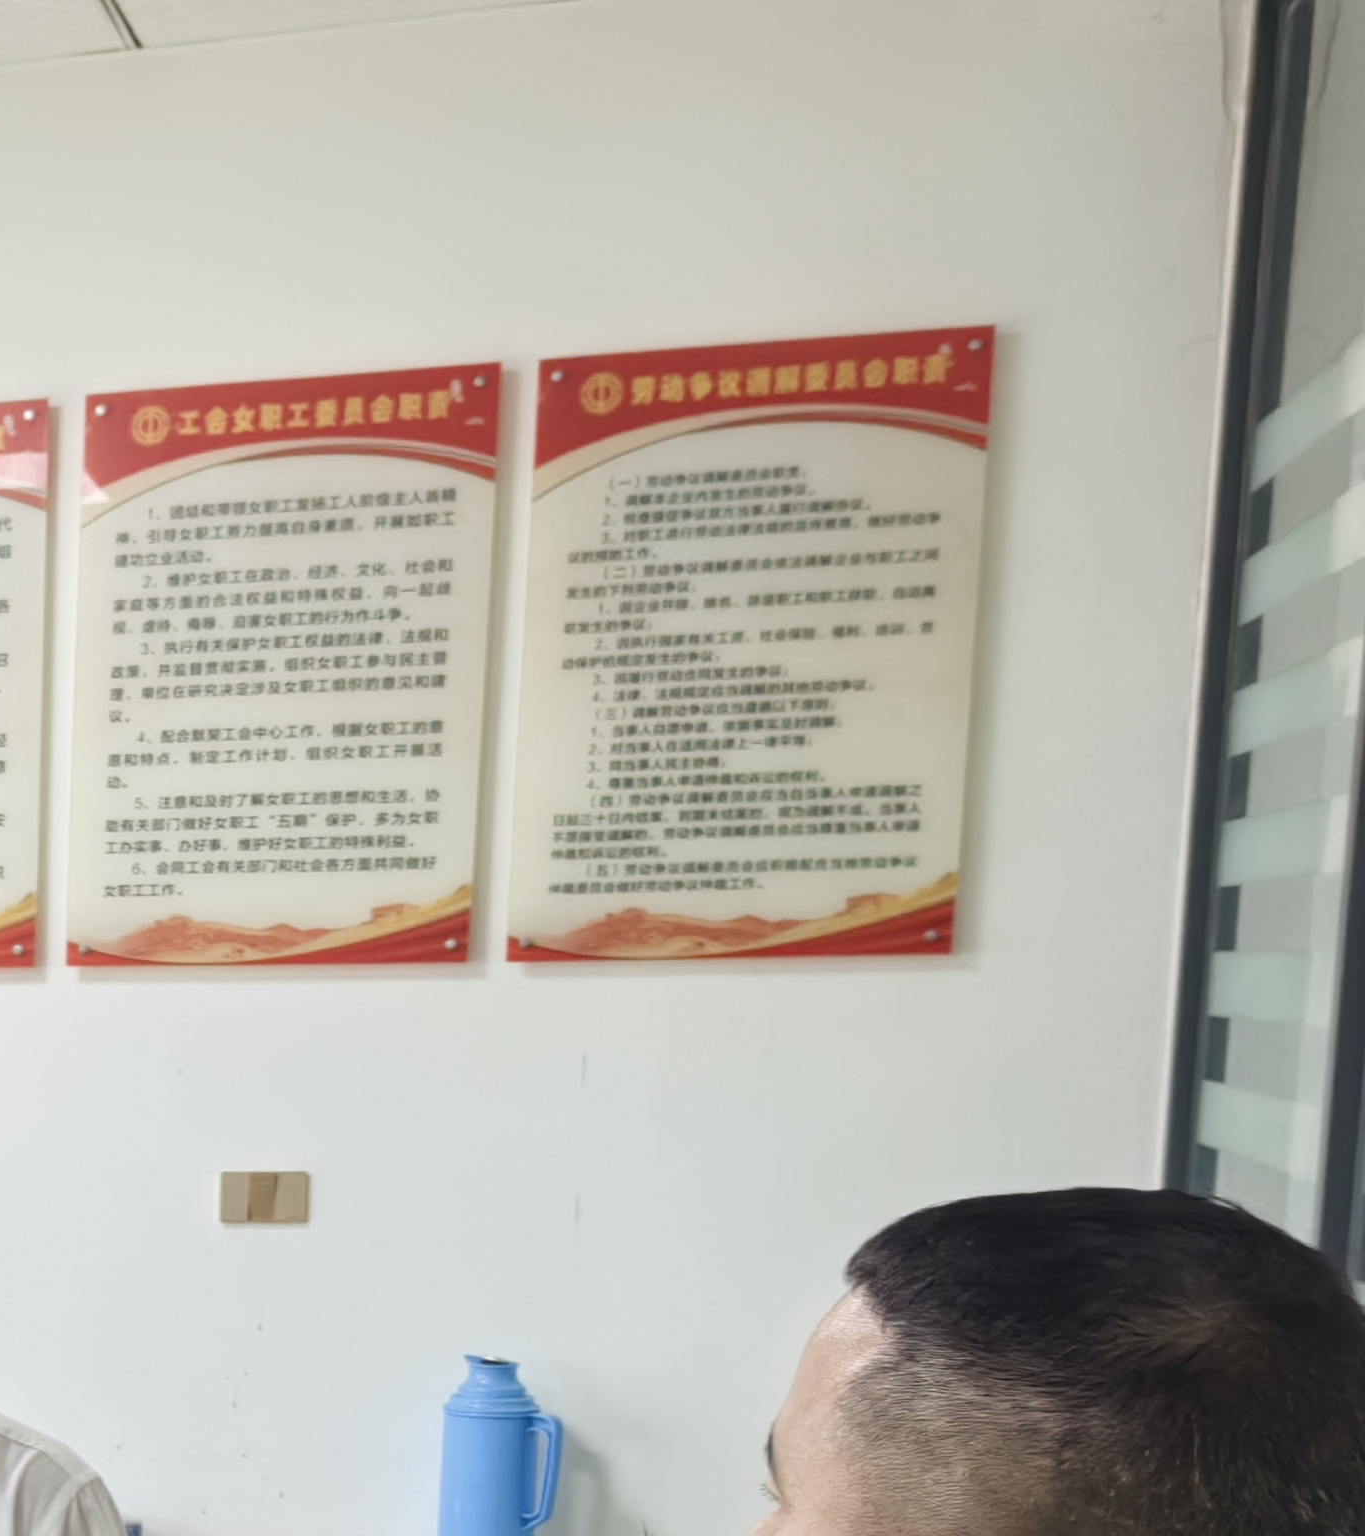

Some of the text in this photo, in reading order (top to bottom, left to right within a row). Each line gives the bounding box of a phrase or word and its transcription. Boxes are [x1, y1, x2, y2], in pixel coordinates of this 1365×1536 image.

[176, 390, 451, 436] 工会女职工委员会职责
[109, 710, 130, 723] 议。
